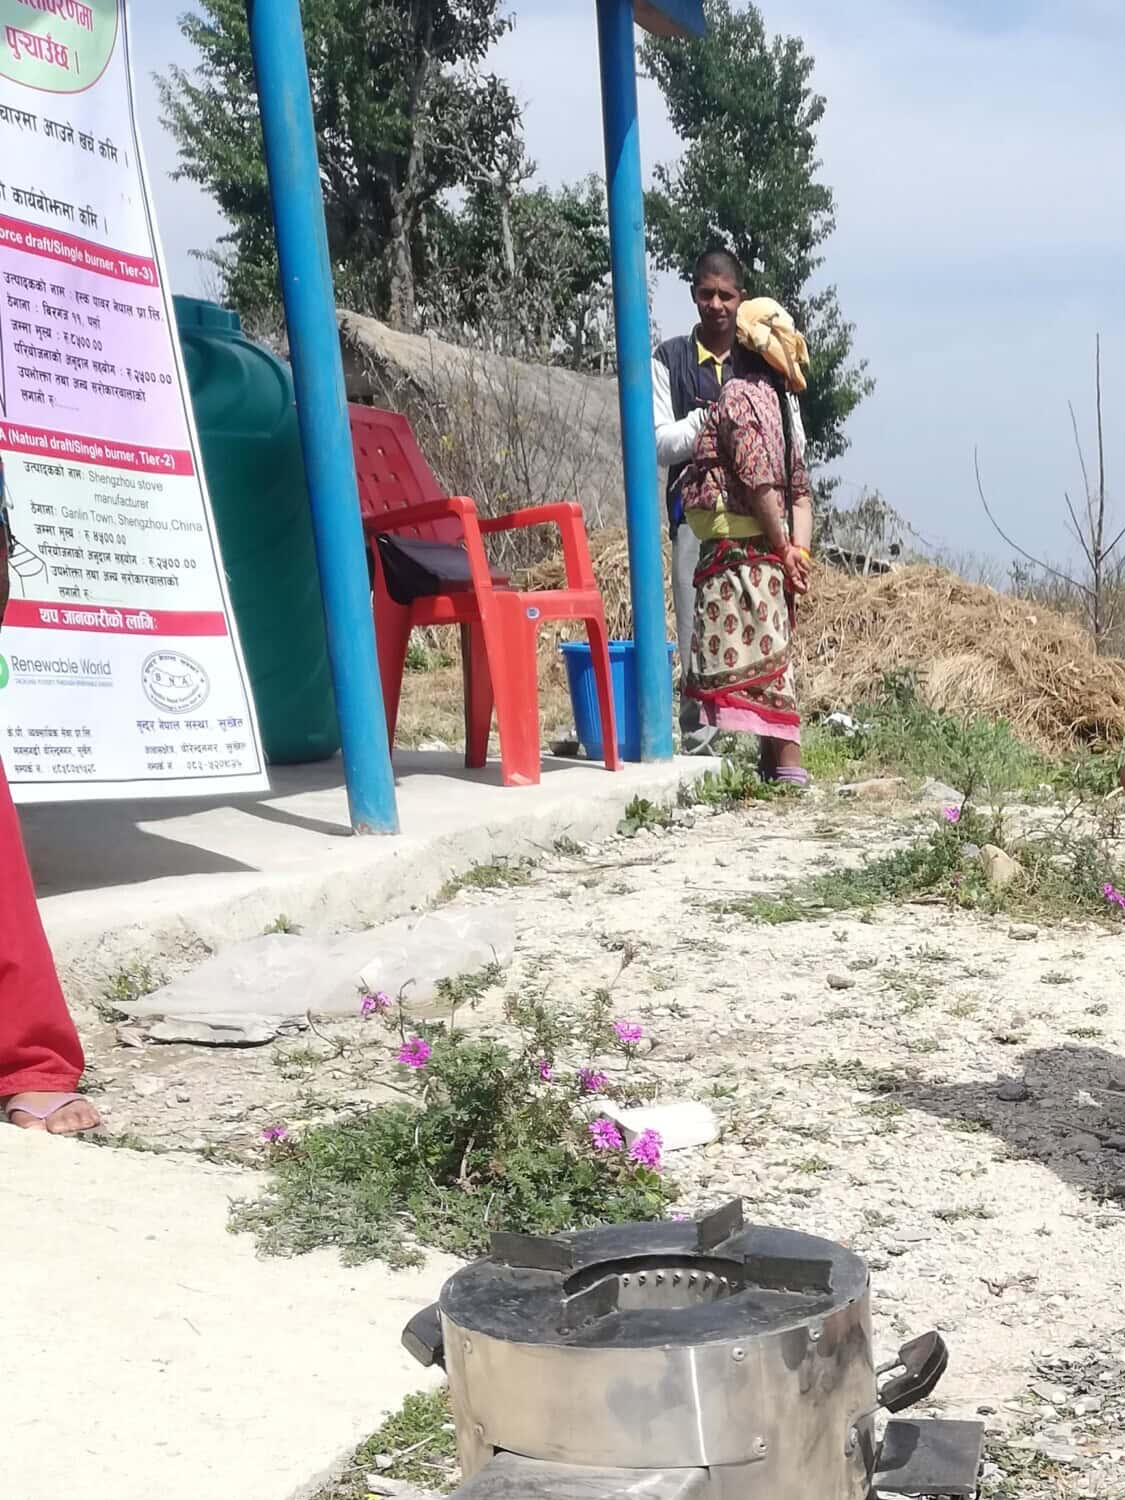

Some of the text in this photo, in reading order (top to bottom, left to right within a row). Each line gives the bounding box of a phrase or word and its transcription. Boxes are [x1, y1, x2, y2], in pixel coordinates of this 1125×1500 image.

[44, 117, 74, 144] आउने
[25, 232, 83, 262] draft/Single
[118, 261, 154, 283] Tier-3)
[8, 428, 48, 449] (Natural
[50, 437, 103, 459] draft/Single
[138, 450, 175, 470] Tier-2)
[88, 470, 136, 489] Shengzhou
[138, 478, 163, 492] stove
[38, 607, 59, 623] थप
[61, 608, 123, 628] जानकारीको
[11, 656, 112, 675] Renewable World
